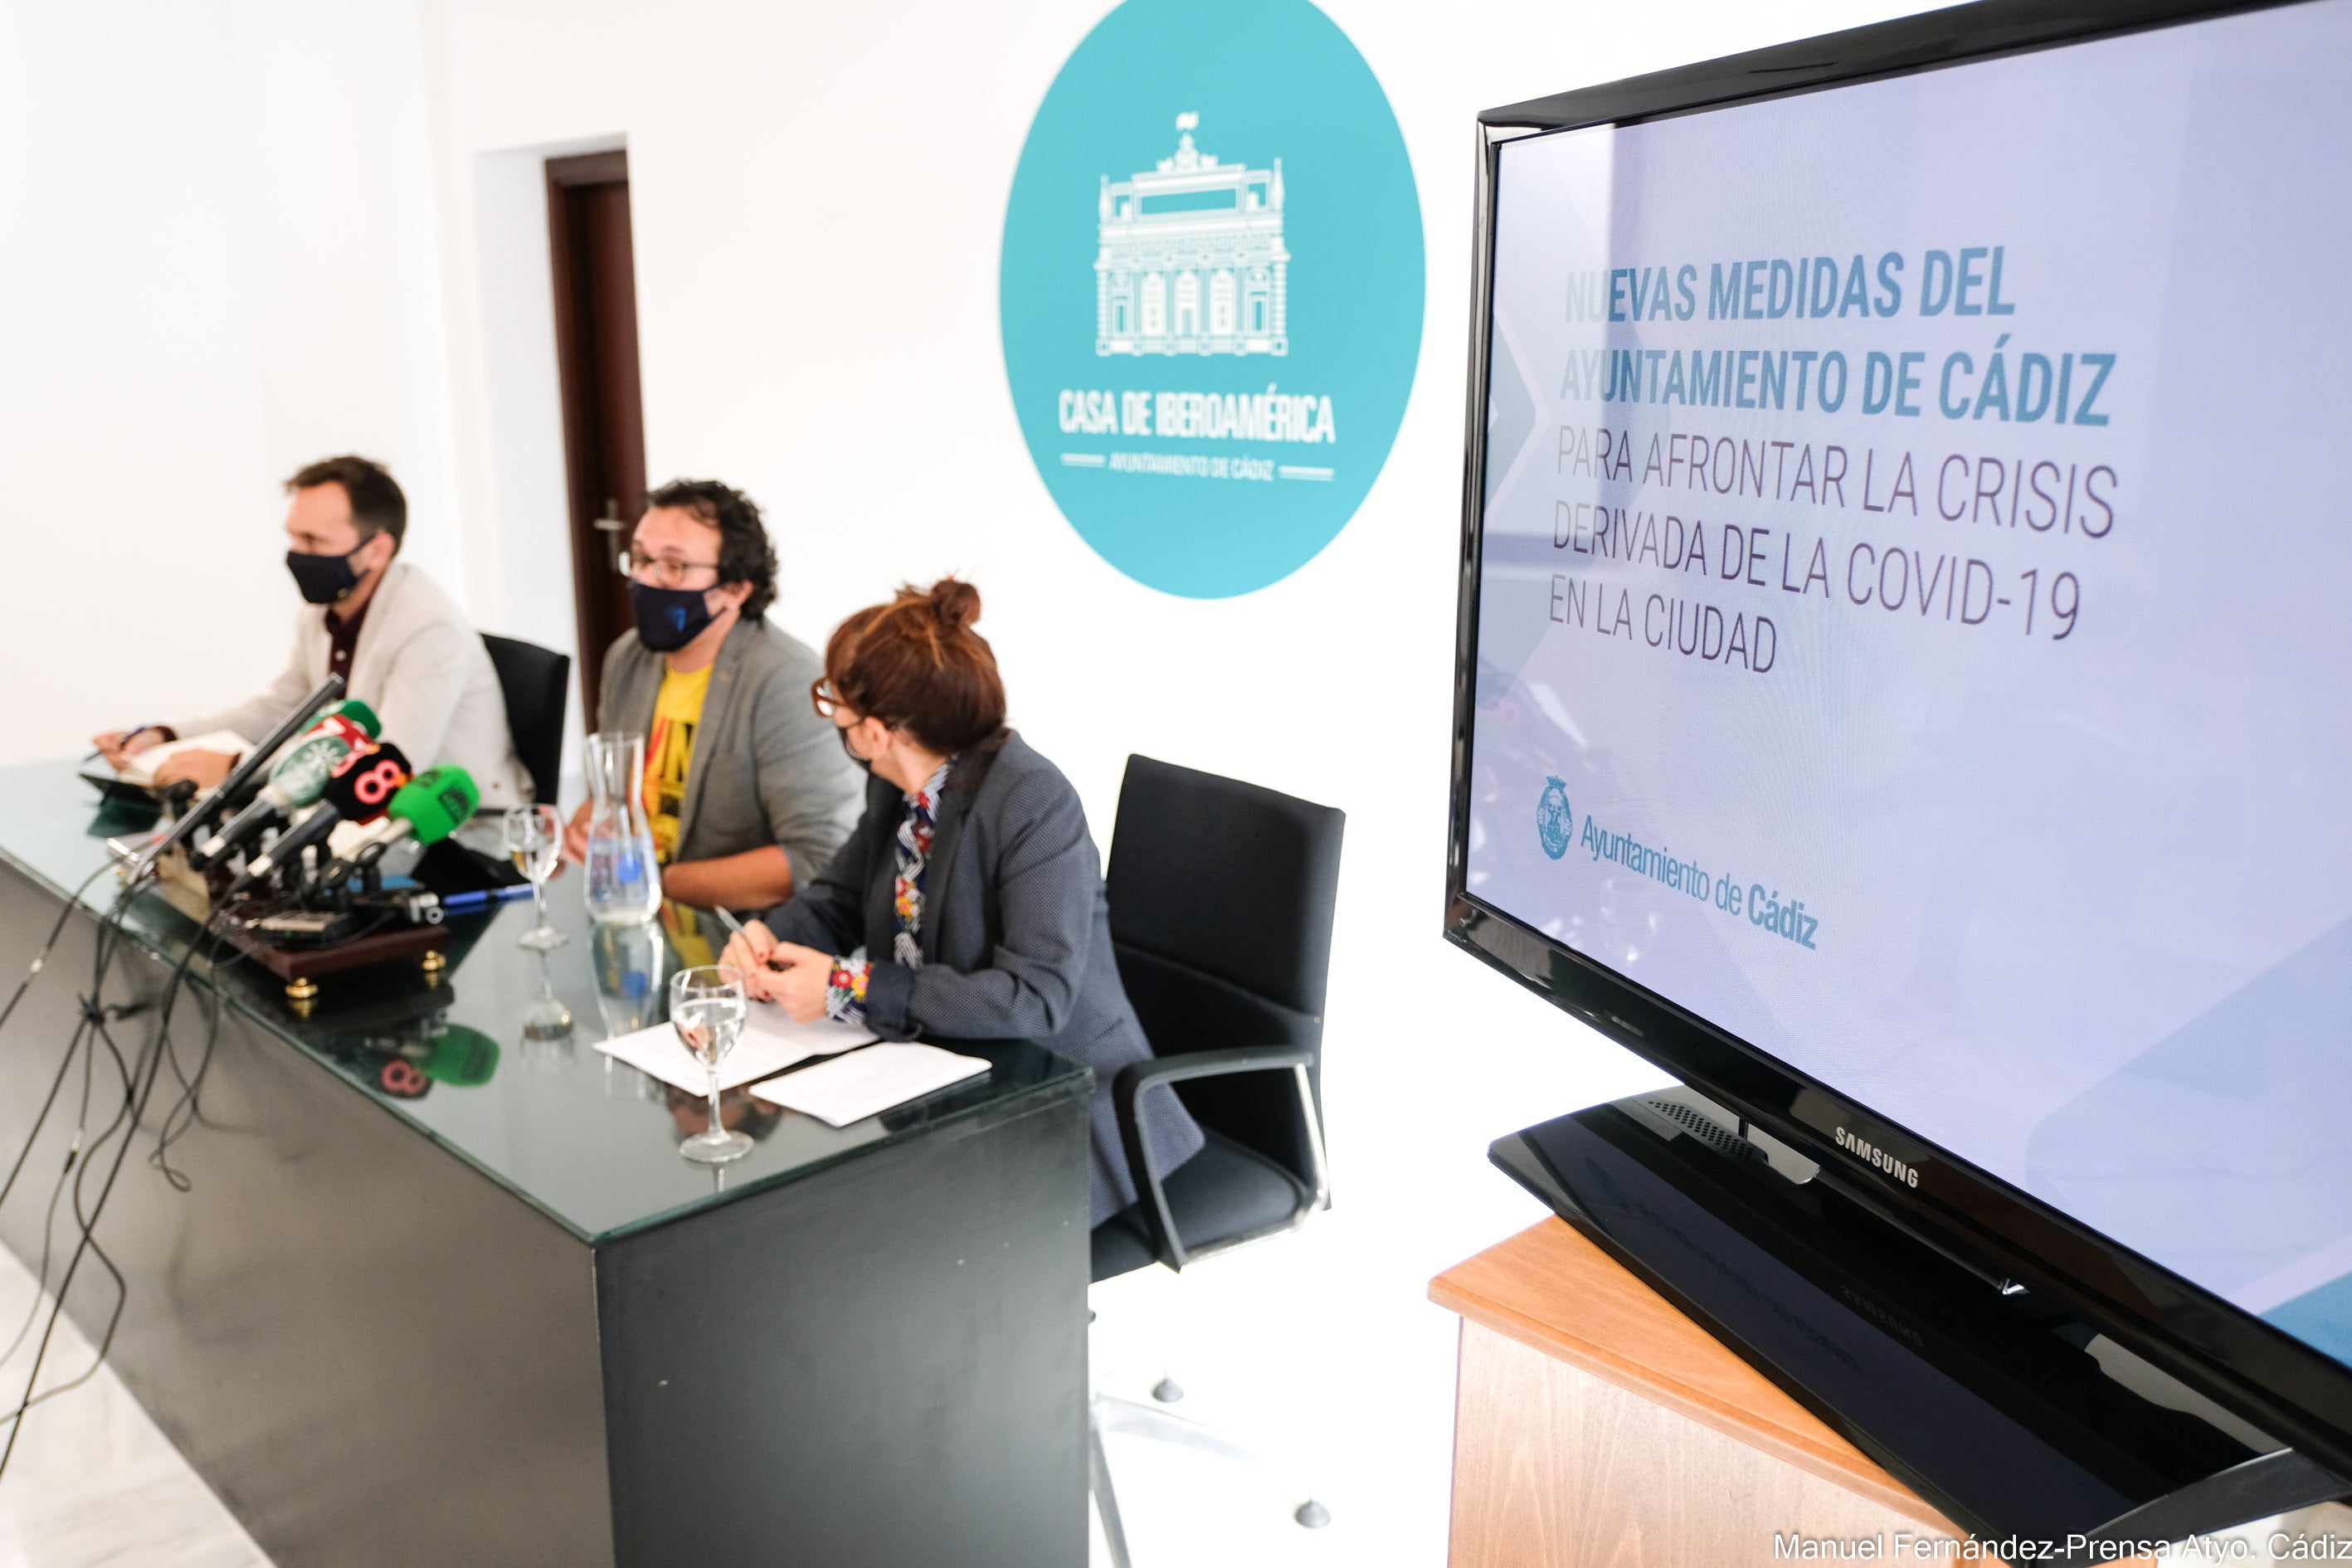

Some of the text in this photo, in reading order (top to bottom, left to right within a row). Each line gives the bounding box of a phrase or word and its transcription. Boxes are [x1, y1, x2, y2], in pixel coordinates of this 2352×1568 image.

[1565, 246, 2016, 324] NUEVAS MEDIDAS DEL
[1059, 382, 1336, 444] CASA DE IBEROAMÉRICA
[1560, 333, 2117, 426] AYUNTAMIENTO DE CÁDIZ
[1108, 452, 1275, 481] AYUNTAMIENTO DE CÁDIZ
[1557, 425, 2118, 538] PARA AFRONTAR LA CRISIS
[1553, 499, 2080, 640] DERIVADA DE LA COVID-19
[1550, 572, 1777, 674] EN LA CIUDAD
[1580, 815, 1819, 951] Ayuntamiento de Cádiz
[1835, 1126, 1919, 1188] SAMSUNG
